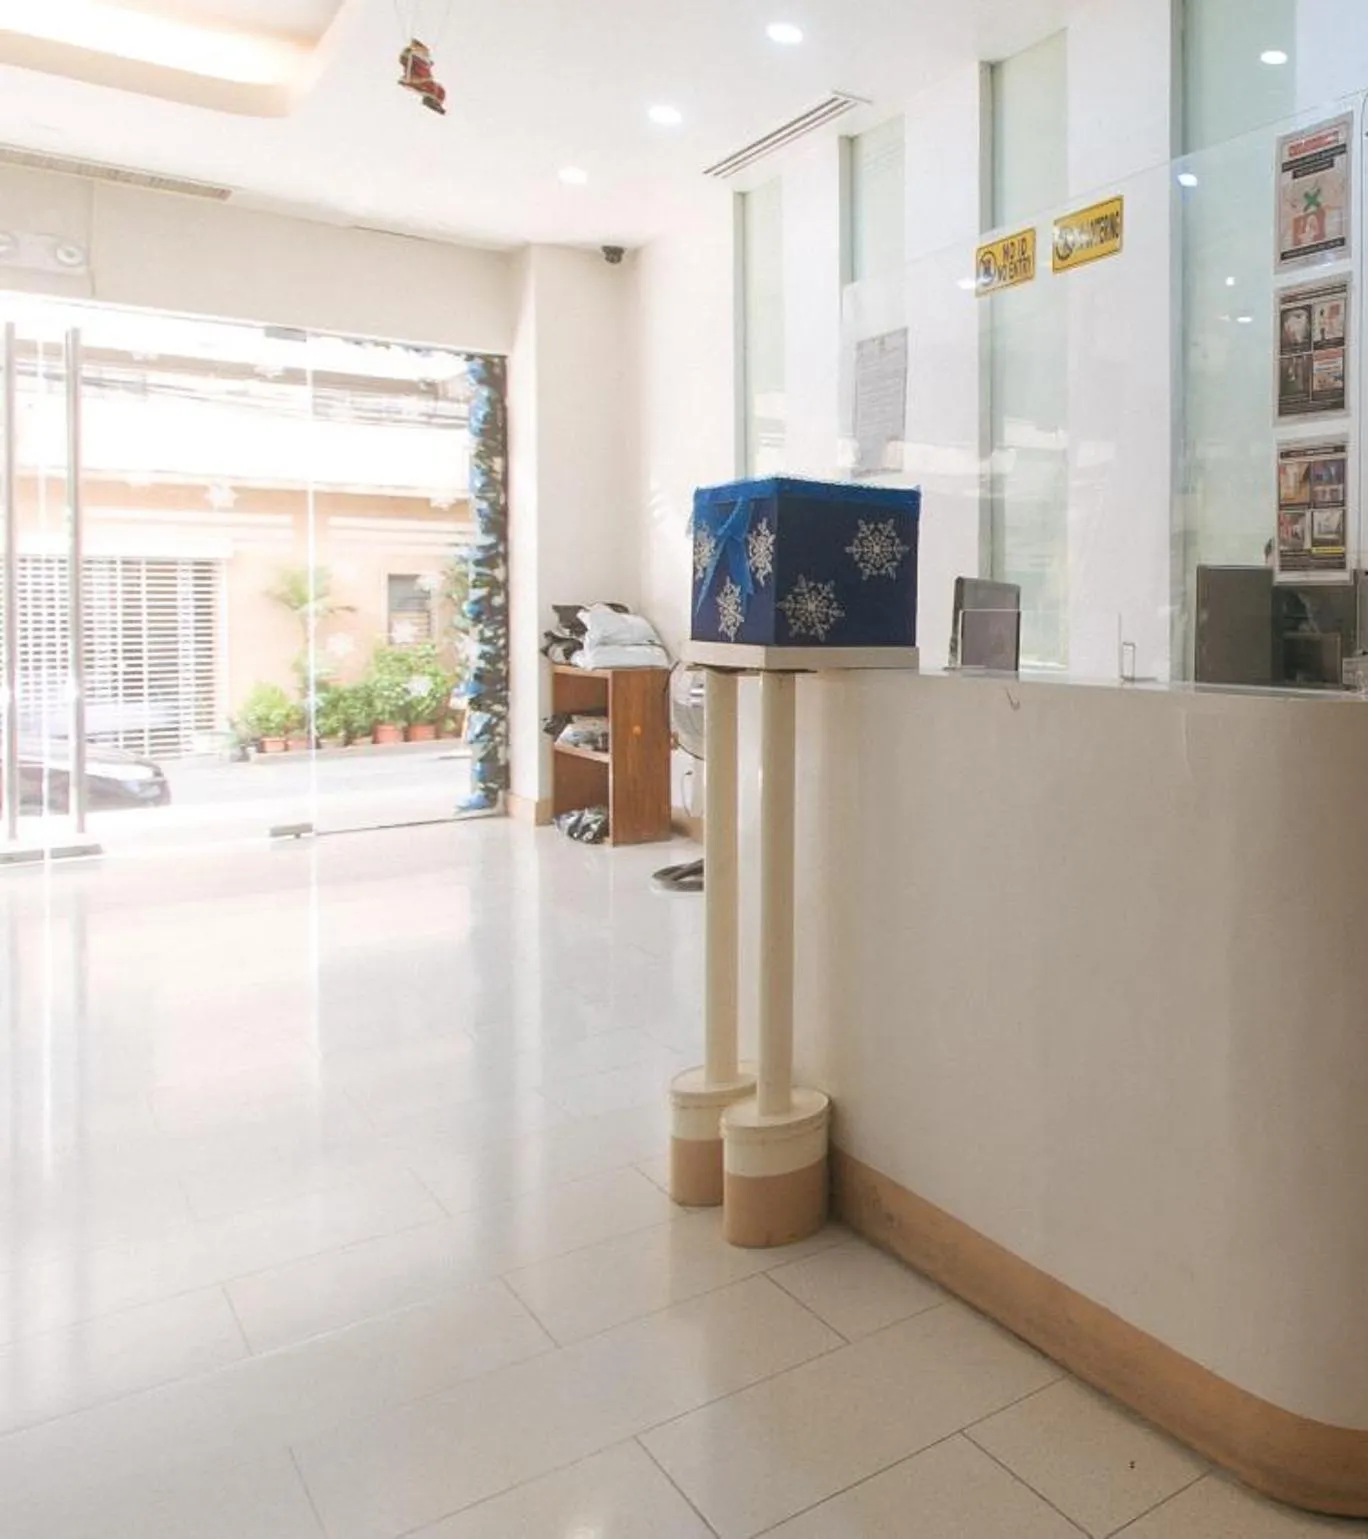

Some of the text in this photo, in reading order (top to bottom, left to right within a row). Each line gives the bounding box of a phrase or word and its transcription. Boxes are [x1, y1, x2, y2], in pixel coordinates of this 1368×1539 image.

[1002, 236, 1027, 263] NO ID
[998, 256, 1031, 281] NO ENTRY
